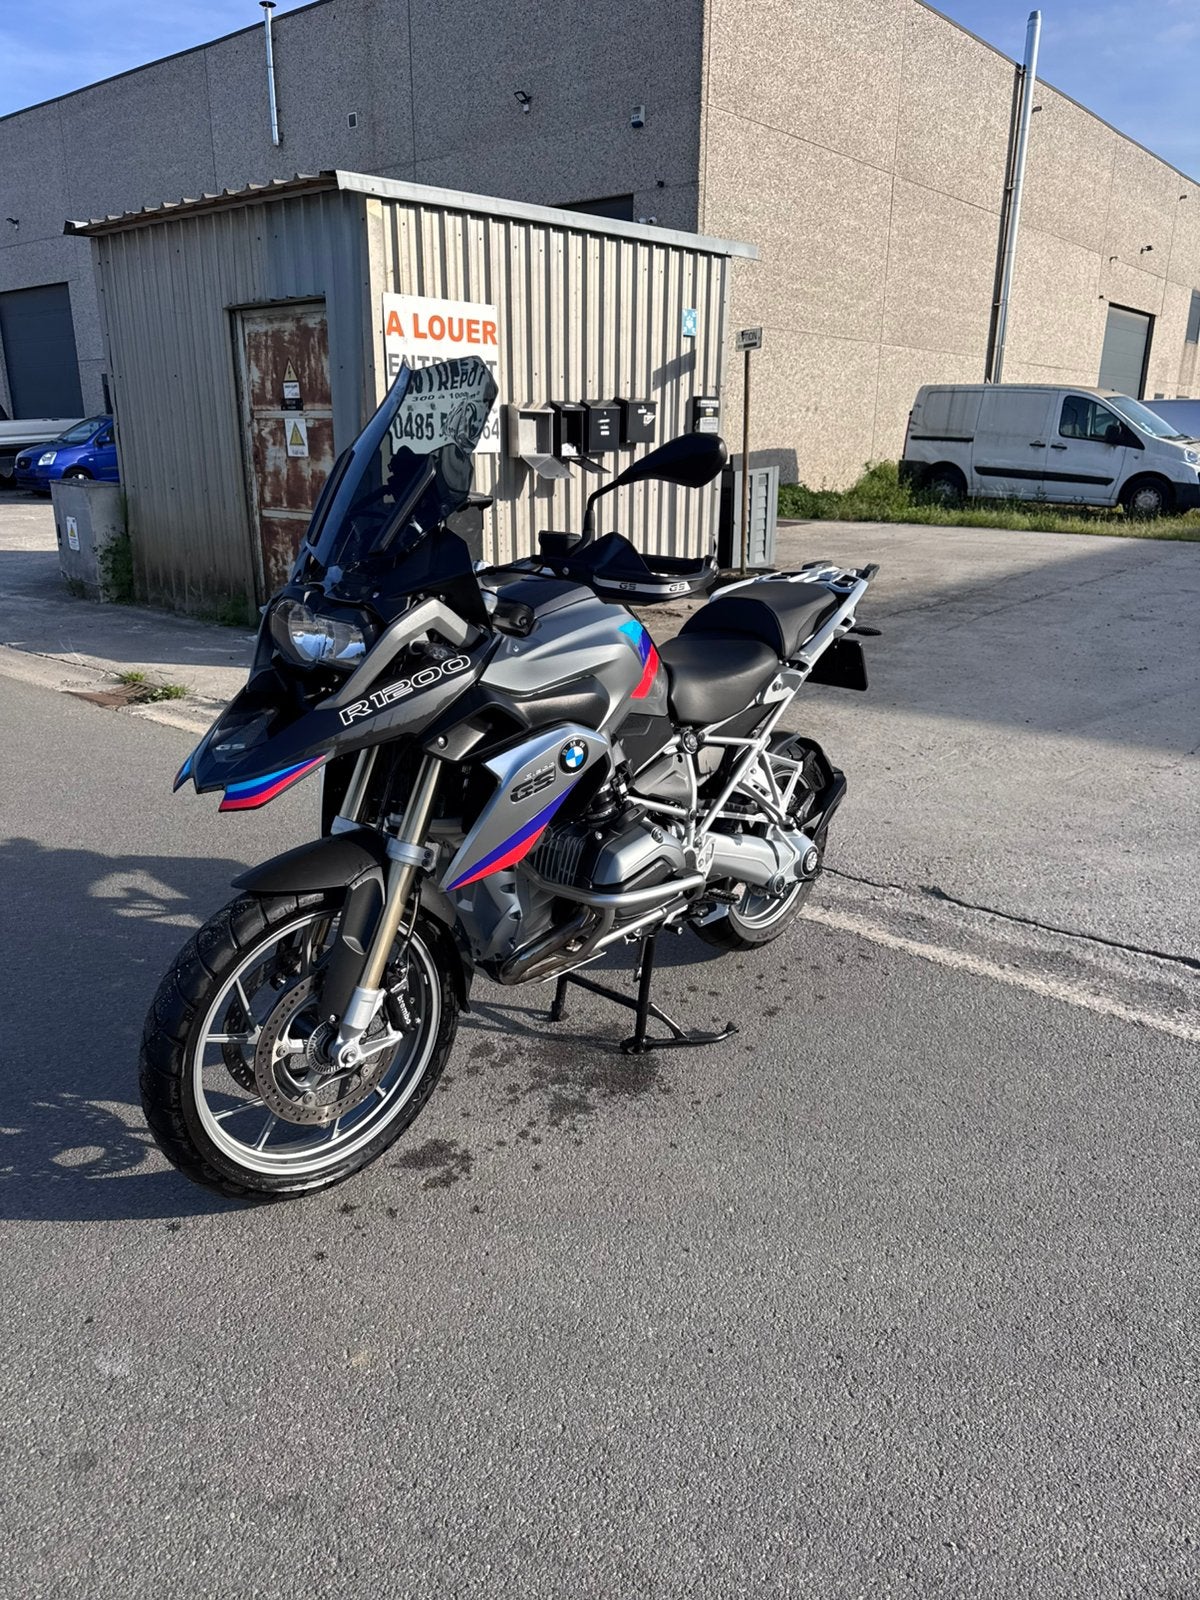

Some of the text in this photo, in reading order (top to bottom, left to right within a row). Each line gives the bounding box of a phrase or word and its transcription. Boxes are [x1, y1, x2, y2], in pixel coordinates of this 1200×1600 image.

[386, 310, 498, 345] A LOUER
[411, 394, 435, 402] 300
[392, 411, 434, 440] 0485
[618, 582, 637, 591] GS
[668, 583, 686, 592] GS
[562, 740, 586, 756] BMW
[510, 766, 556, 804] GS
[396, 993, 412, 1025] brembo
